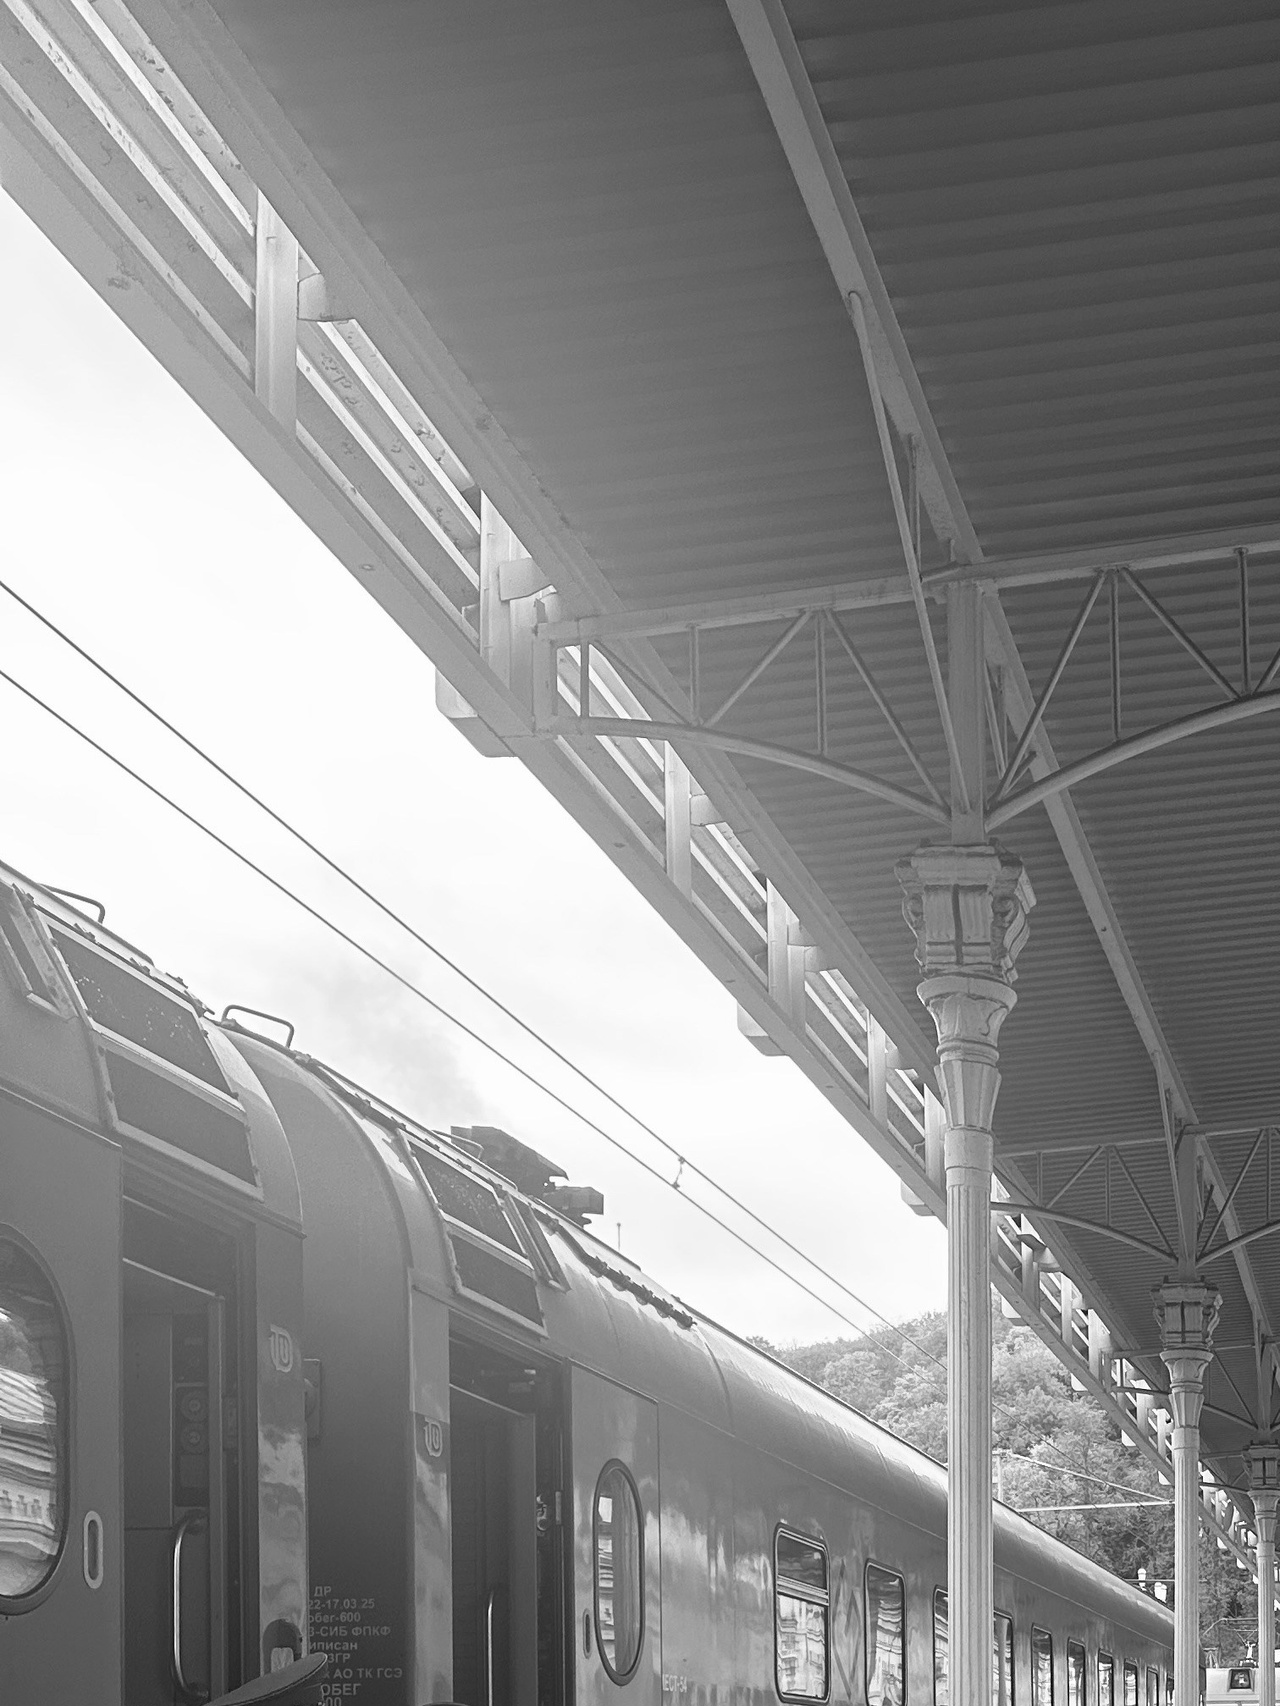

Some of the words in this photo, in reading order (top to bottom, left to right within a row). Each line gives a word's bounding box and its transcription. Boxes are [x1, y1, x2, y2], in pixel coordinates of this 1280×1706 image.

[314, 1586, 332, 1597] ДР
[333, 1668, 353, 1679] АО
[357, 1668, 374, 1679] ТК
